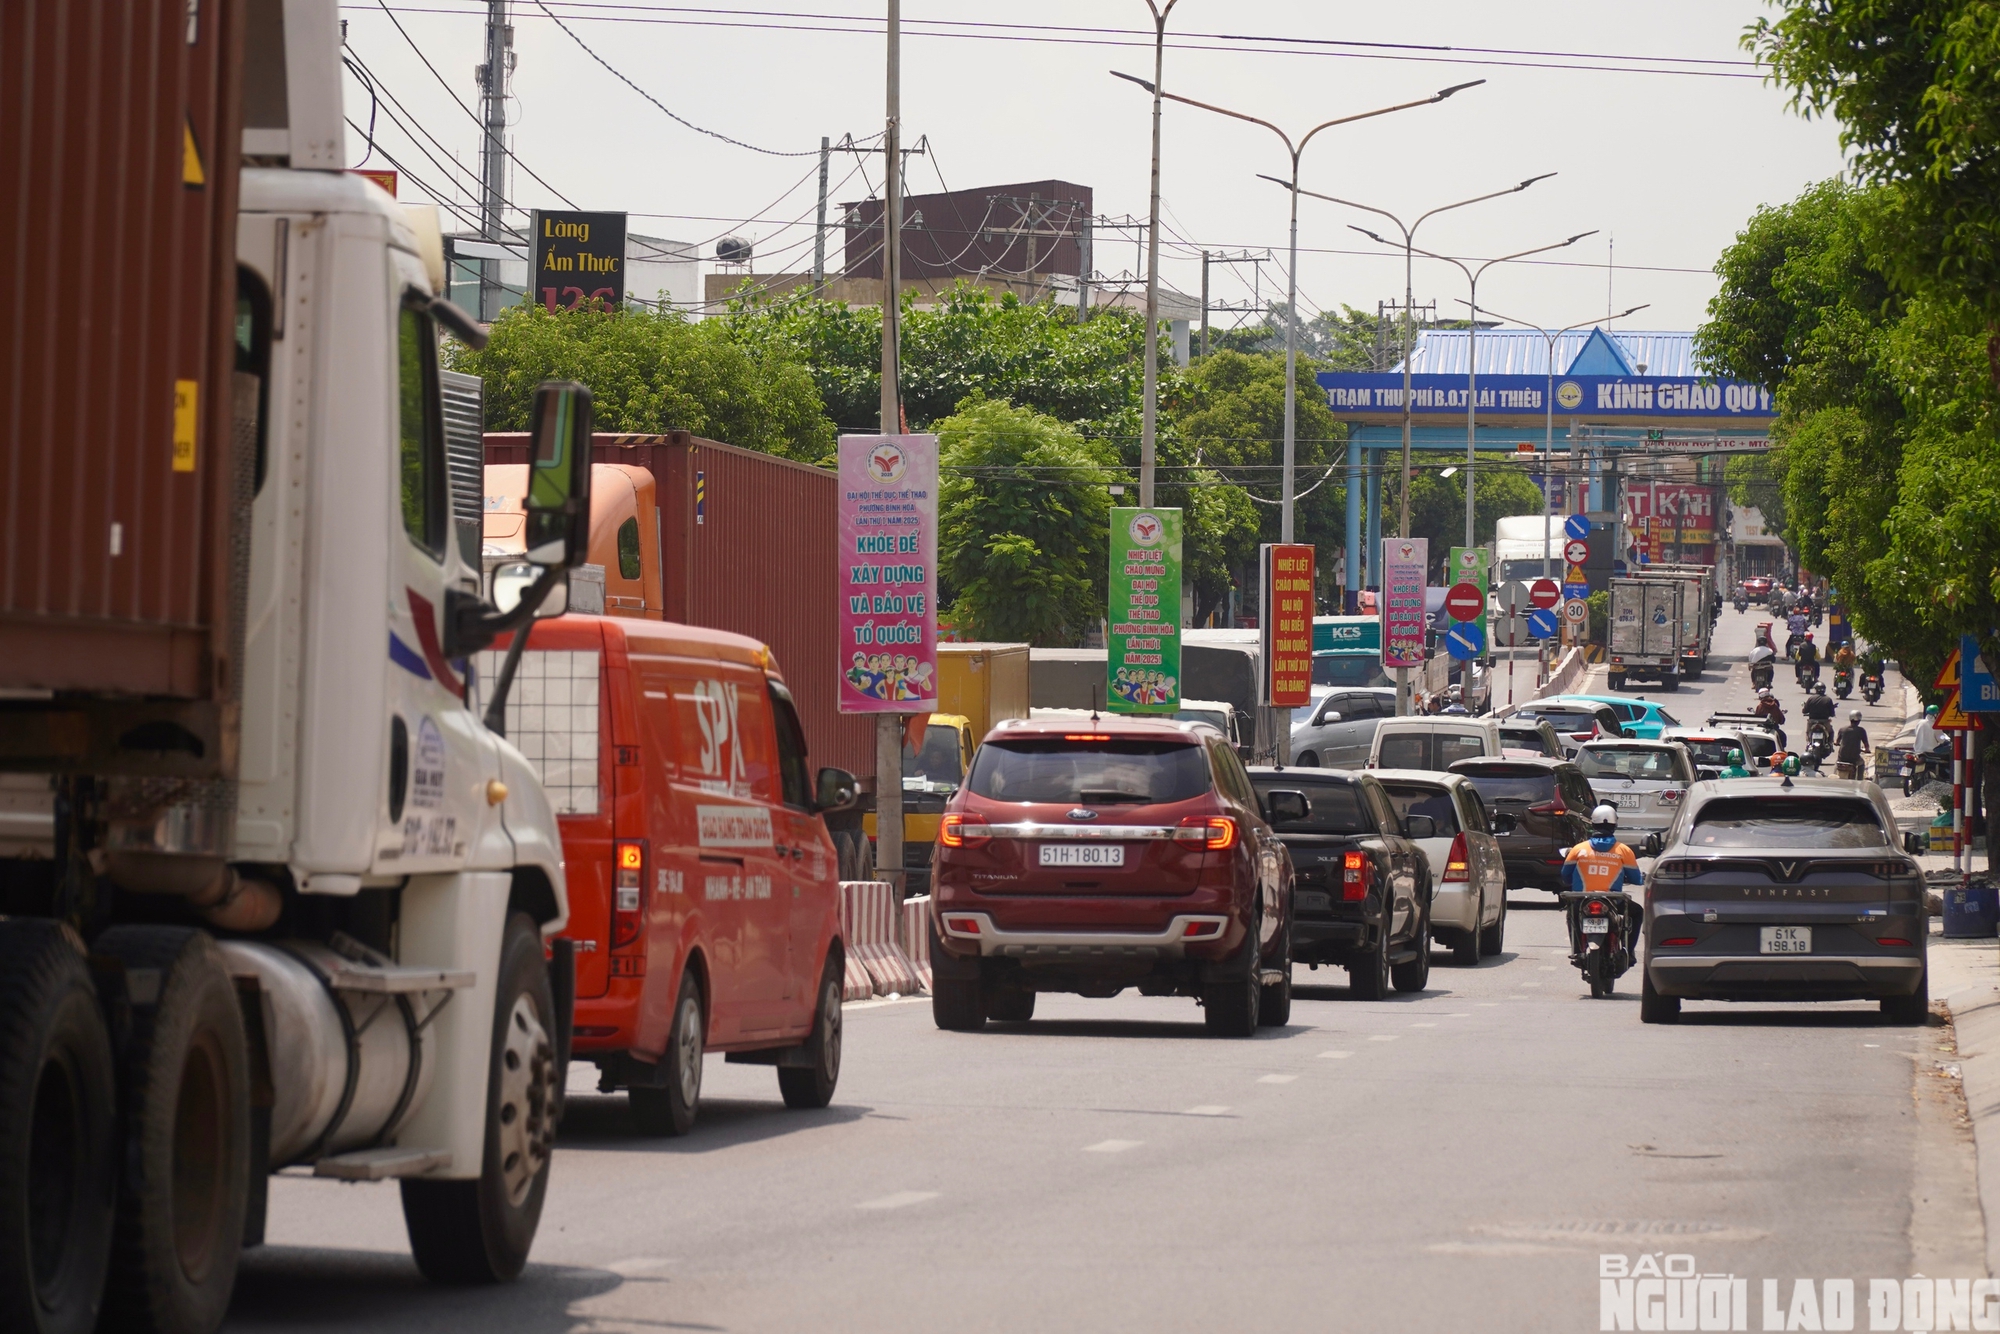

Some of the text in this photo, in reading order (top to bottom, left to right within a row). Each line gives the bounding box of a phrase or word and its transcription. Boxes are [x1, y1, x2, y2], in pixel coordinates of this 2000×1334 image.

[545, 219, 590, 242] Làng
[544, 244, 619, 275] Ẩm Thực
[1328, 388, 1370, 409] TRẠM
[1375, 389, 1404, 406] THU
[1410, 386, 1432, 407] PHÍ
[1500, 386, 1542, 408] THIÊU
[1597, 379, 1653, 409] KÍNH
[1658, 380, 1720, 410] CHÀO
[911, 490, 927, 498] THAO
[904, 516, 918, 524] 2025
[857, 530, 918, 552] KHỎE ĐỂ
[1128, 549, 1162, 561] NHIỆT LIỆT
[1126, 564, 1164, 574] CHÀO MỪNG
[1278, 557, 1308, 574] NHIỆT LIỆT
[851, 564, 924, 586] XÂY DỰNG
[1132, 579, 1157, 592] ĐẠI HỘI
[1276, 578, 1310, 591] CHÀO MỪNG
[850, 591, 926, 617] VÀ BẢO VỆ
[1144, 595, 1158, 607] DỤC
[1282, 597, 1303, 614] ĐẠI HỘI
[1142, 610, 1160, 620] THAO
[1568, 606, 1583, 616] 30
[854, 620, 921, 645] TỔ QUỐC!
[1114, 622, 1140, 634] PHƯỜNG
[1142, 622, 1159, 634] BÌNH
[1280, 619, 1290, 634] ĐẠI
[1332, 626, 1362, 638] KES
[1276, 636, 1308, 652] TOÀN QUỐC
[1125, 652, 1140, 664] NĂM
[1275, 656, 1286, 672] LẦN
[1276, 676, 1288, 692] CỦA
[694, 680, 746, 796] SPX
[1042, 846, 1120, 864] 51H-180.13
[1776, 929, 1796, 940] 61K
[1768, 941, 1806, 952] 198.18
